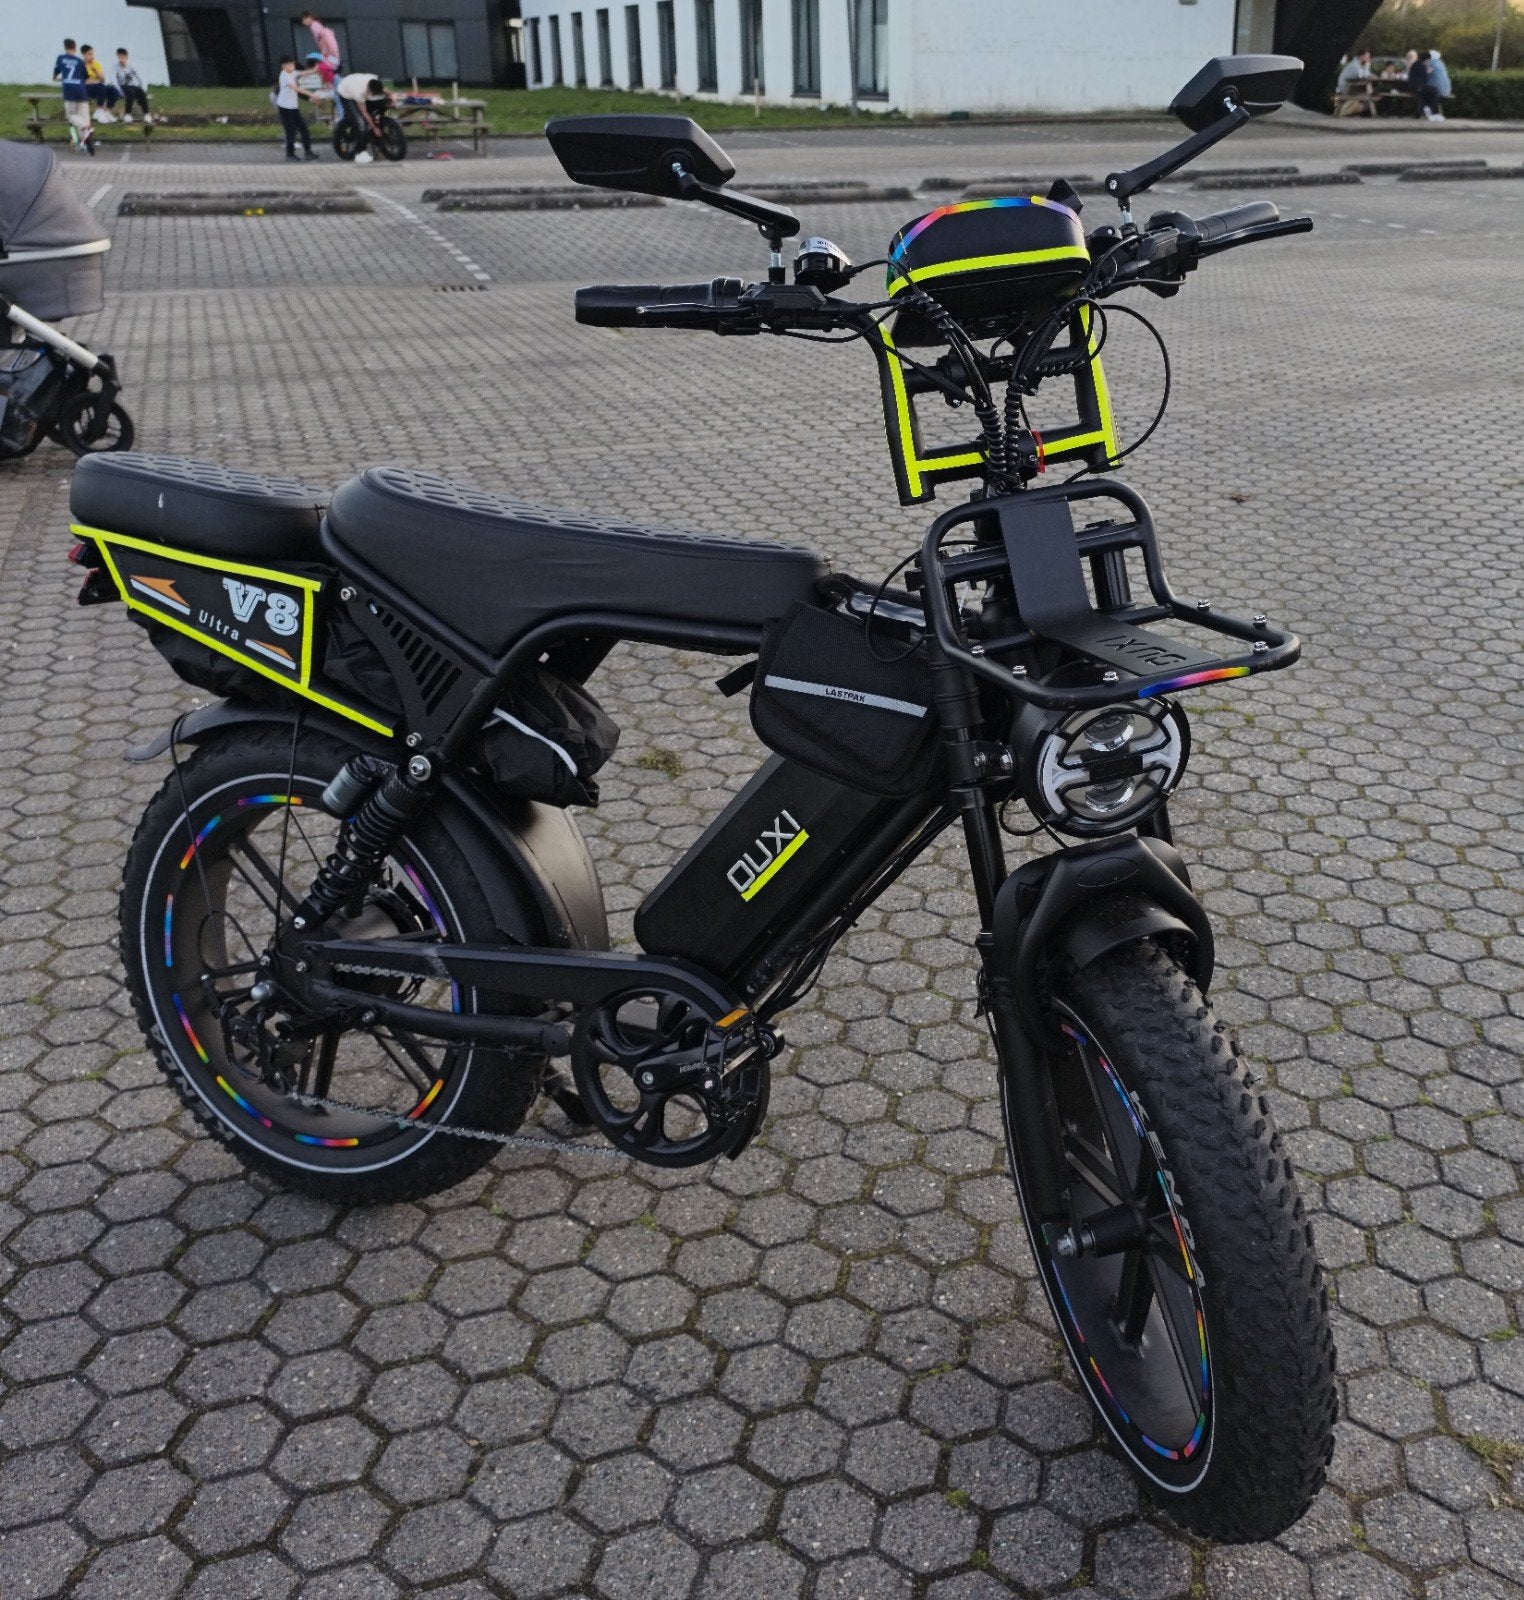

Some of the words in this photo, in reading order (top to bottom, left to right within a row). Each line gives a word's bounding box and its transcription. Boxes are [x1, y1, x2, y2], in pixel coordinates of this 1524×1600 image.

[64, 64, 76, 80] 7
[198, 609, 240, 641] Ultra
[222, 576, 300, 637] V8
[825, 687, 866, 702] LASTPAK
[726, 809, 801, 892] OUXI
[150, 1022, 236, 1141] KENDA
[1130, 1090, 1206, 1288] KENDA
